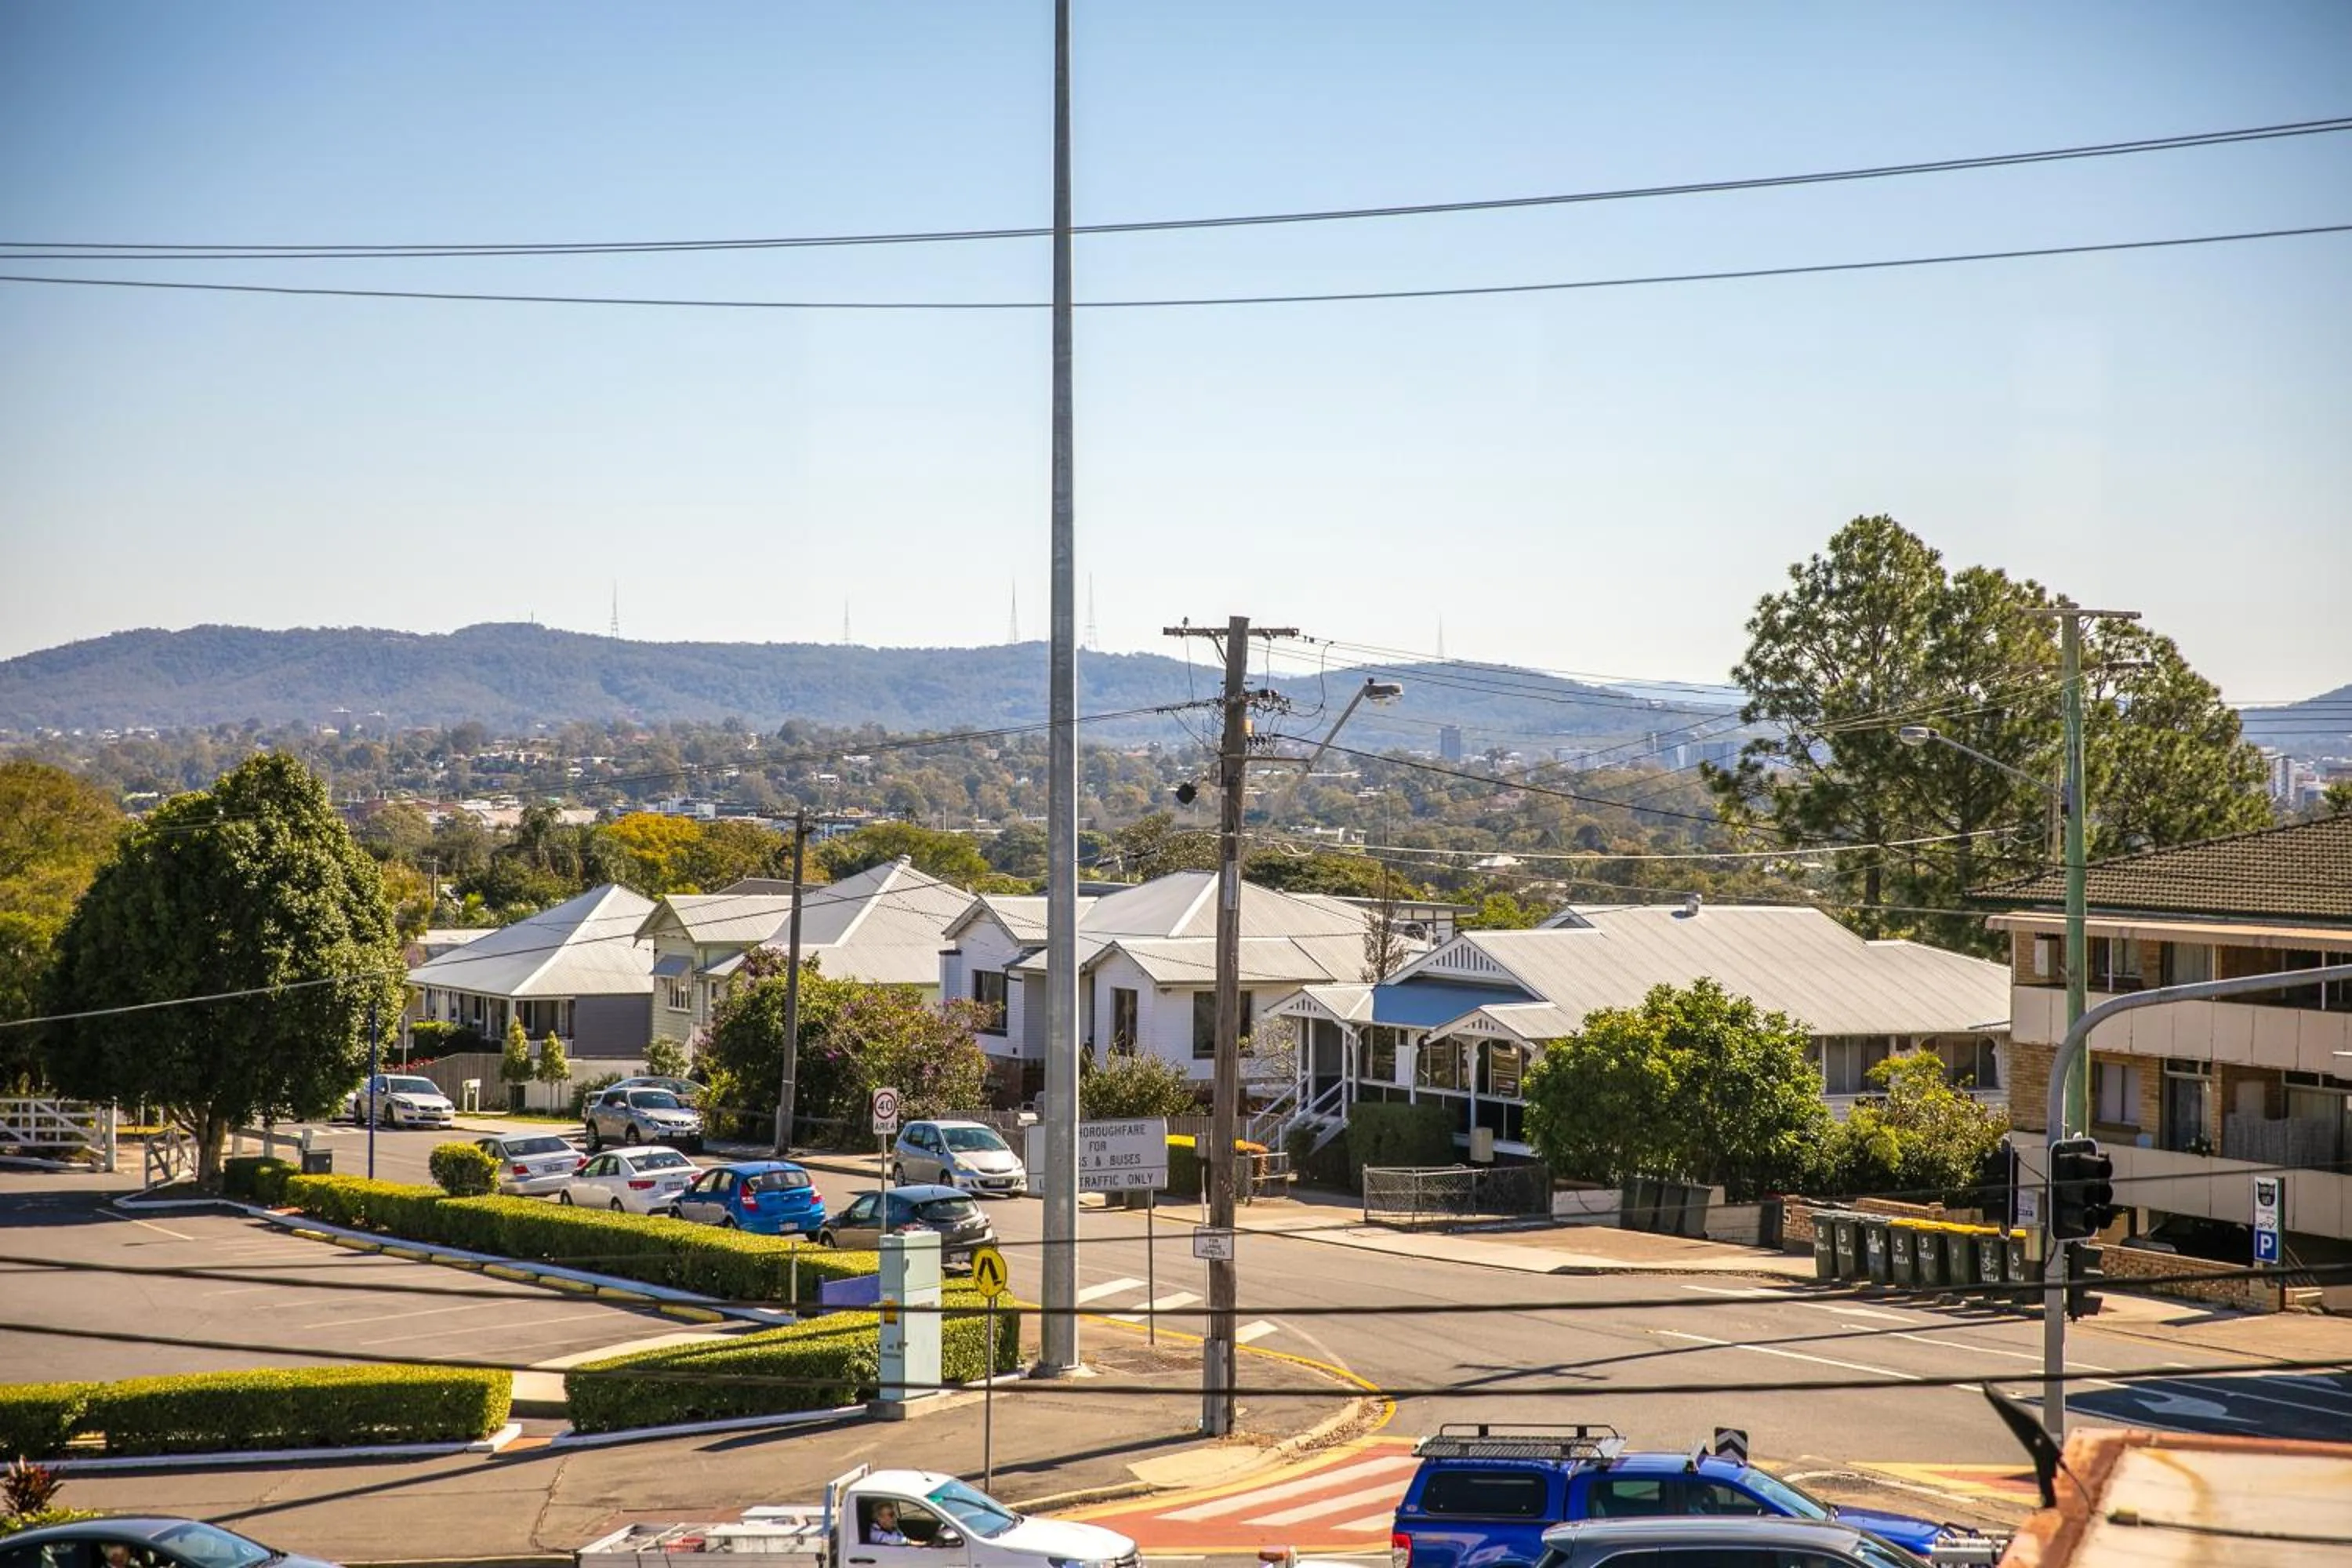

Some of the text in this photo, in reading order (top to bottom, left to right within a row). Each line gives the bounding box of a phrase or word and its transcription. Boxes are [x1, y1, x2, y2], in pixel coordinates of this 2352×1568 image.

[878, 1099, 892, 1111] 40
[1089, 1141, 1107, 1152] FOR
[1109, 1153, 1142, 1166] BUSES
[1079, 1173, 1153, 1187] TRAFFIC ONLY
[1783, 1205, 1791, 1225] 5
[1840, 1229, 1846, 1243] 5
[1896, 1239, 1904, 1252] 5
[2260, 1233, 2273, 1255] P
[2013, 1253, 2020, 1266] 5
